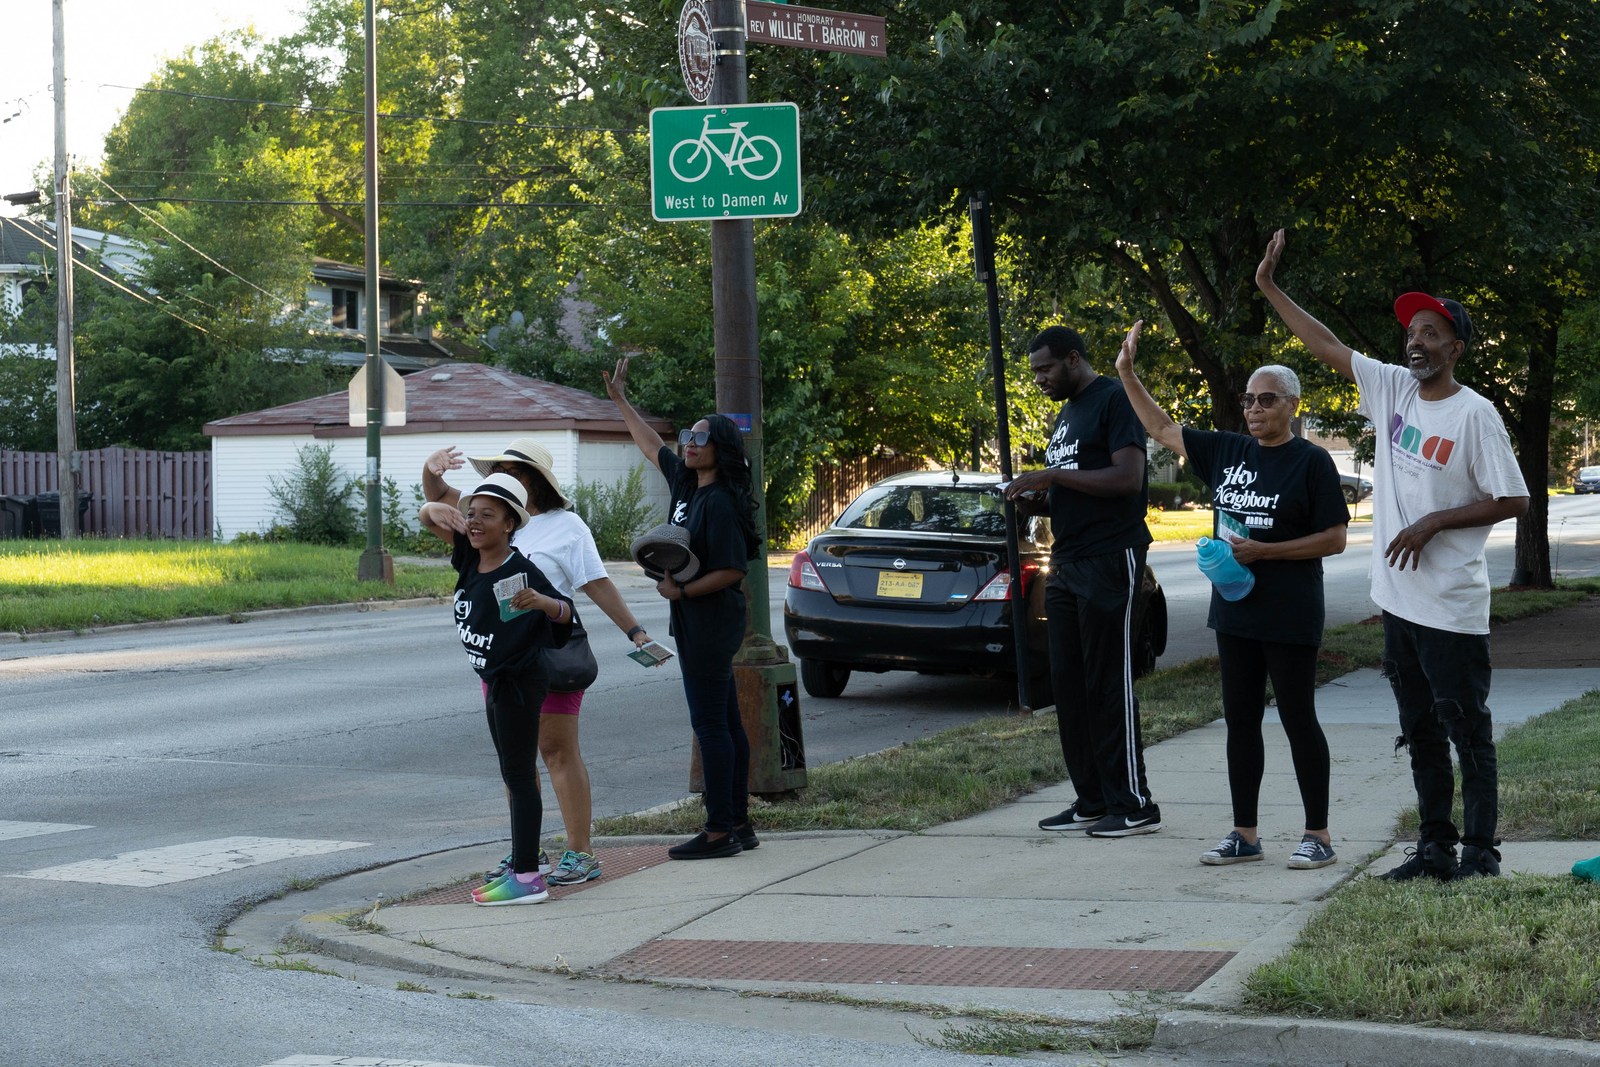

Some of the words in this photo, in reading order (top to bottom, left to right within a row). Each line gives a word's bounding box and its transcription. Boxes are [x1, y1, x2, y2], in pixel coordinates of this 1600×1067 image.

[797, 13, 834, 26] HONORARY
[750, 20, 764, 33] REV
[768, 19, 804, 42] WILLIE
[808, 24, 818, 43] T.
[822, 26, 866, 49] BARROW
[870, 35, 879, 47] ST
[664, 195, 695, 209] West
[702, 194, 715, 208] to
[722, 193, 766, 207] Damen
[773, 191, 788, 206] Av
[1222, 461, 1258, 489] Hey
[1213, 485, 1280, 510] Neighbor!
